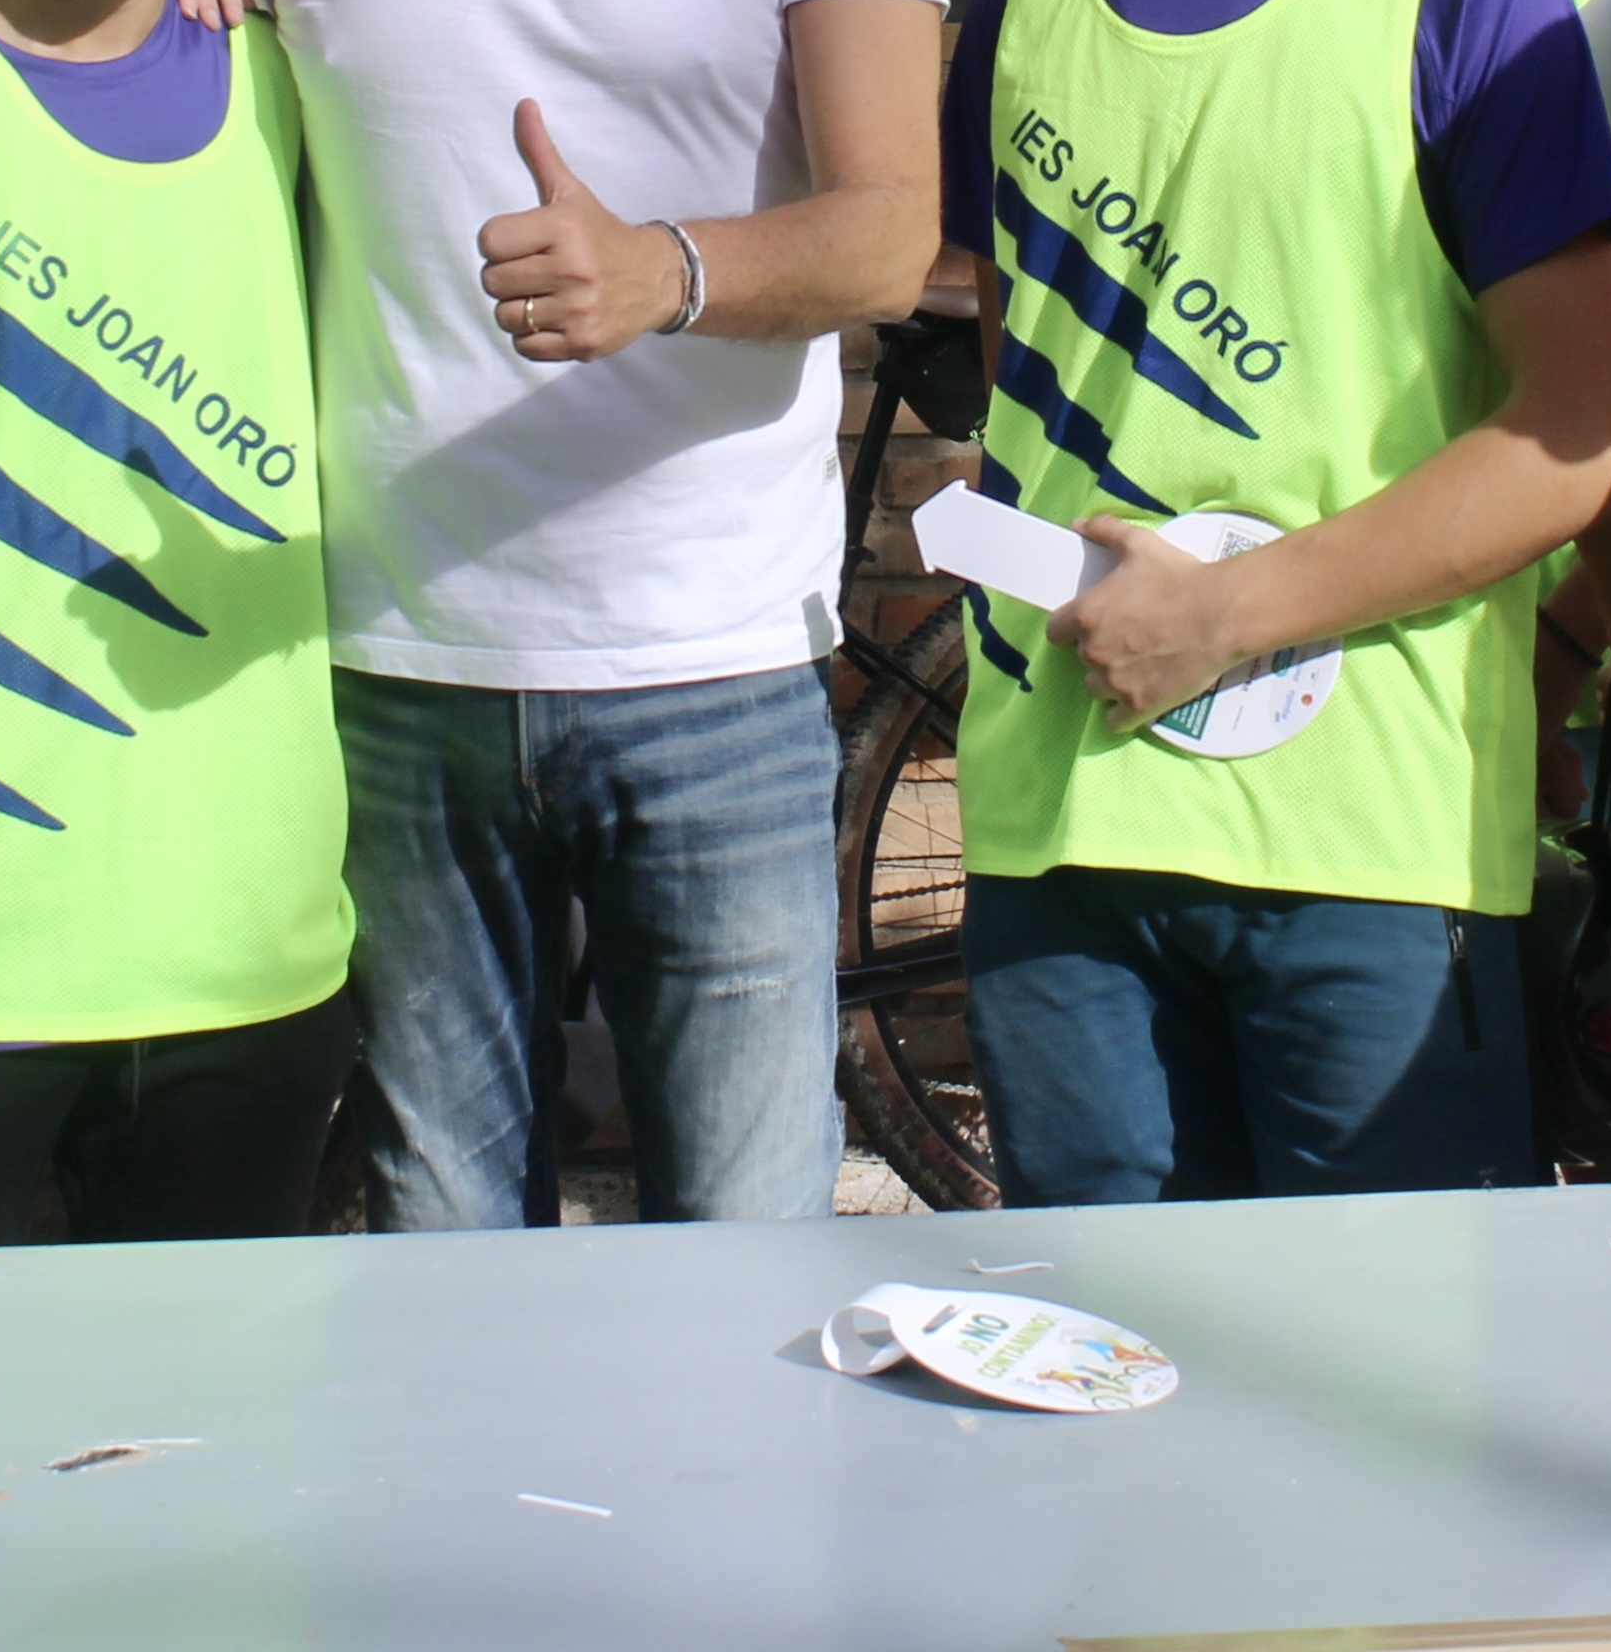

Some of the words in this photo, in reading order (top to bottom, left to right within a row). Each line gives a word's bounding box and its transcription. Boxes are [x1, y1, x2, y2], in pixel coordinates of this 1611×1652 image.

[1010, 108, 1074, 182] IES
[1071, 176, 1180, 288] JOAN
[1172, 279, 1290, 384] ORÓ
[65, 293, 199, 404] JOAN
[194, 393, 298, 489] ORÓ
[958, 1313, 1009, 1343] NO
